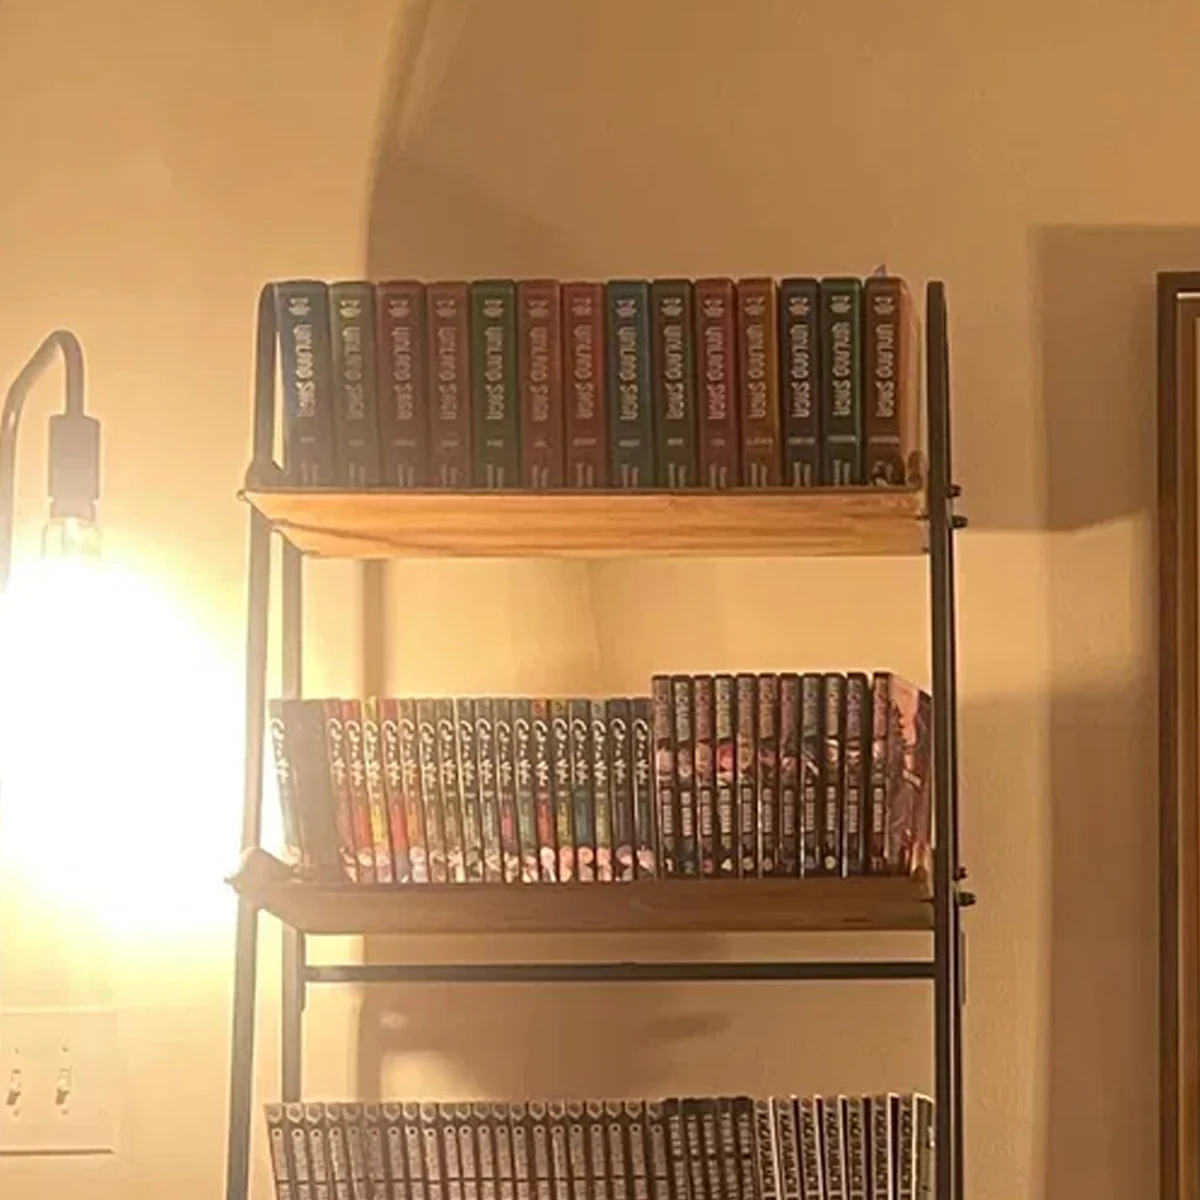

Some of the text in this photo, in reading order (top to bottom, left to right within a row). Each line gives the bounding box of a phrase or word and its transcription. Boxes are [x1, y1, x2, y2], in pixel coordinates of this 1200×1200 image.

[619, 384, 638, 420] SAGA
[666, 384, 685, 420] SAGA
[707, 384, 726, 420] SAGA
[749, 382, 766, 419] SAGA
[791, 382, 811, 418] SAGA
[833, 380, 851, 417] SAGA
[876, 381, 894, 418] SAGA
